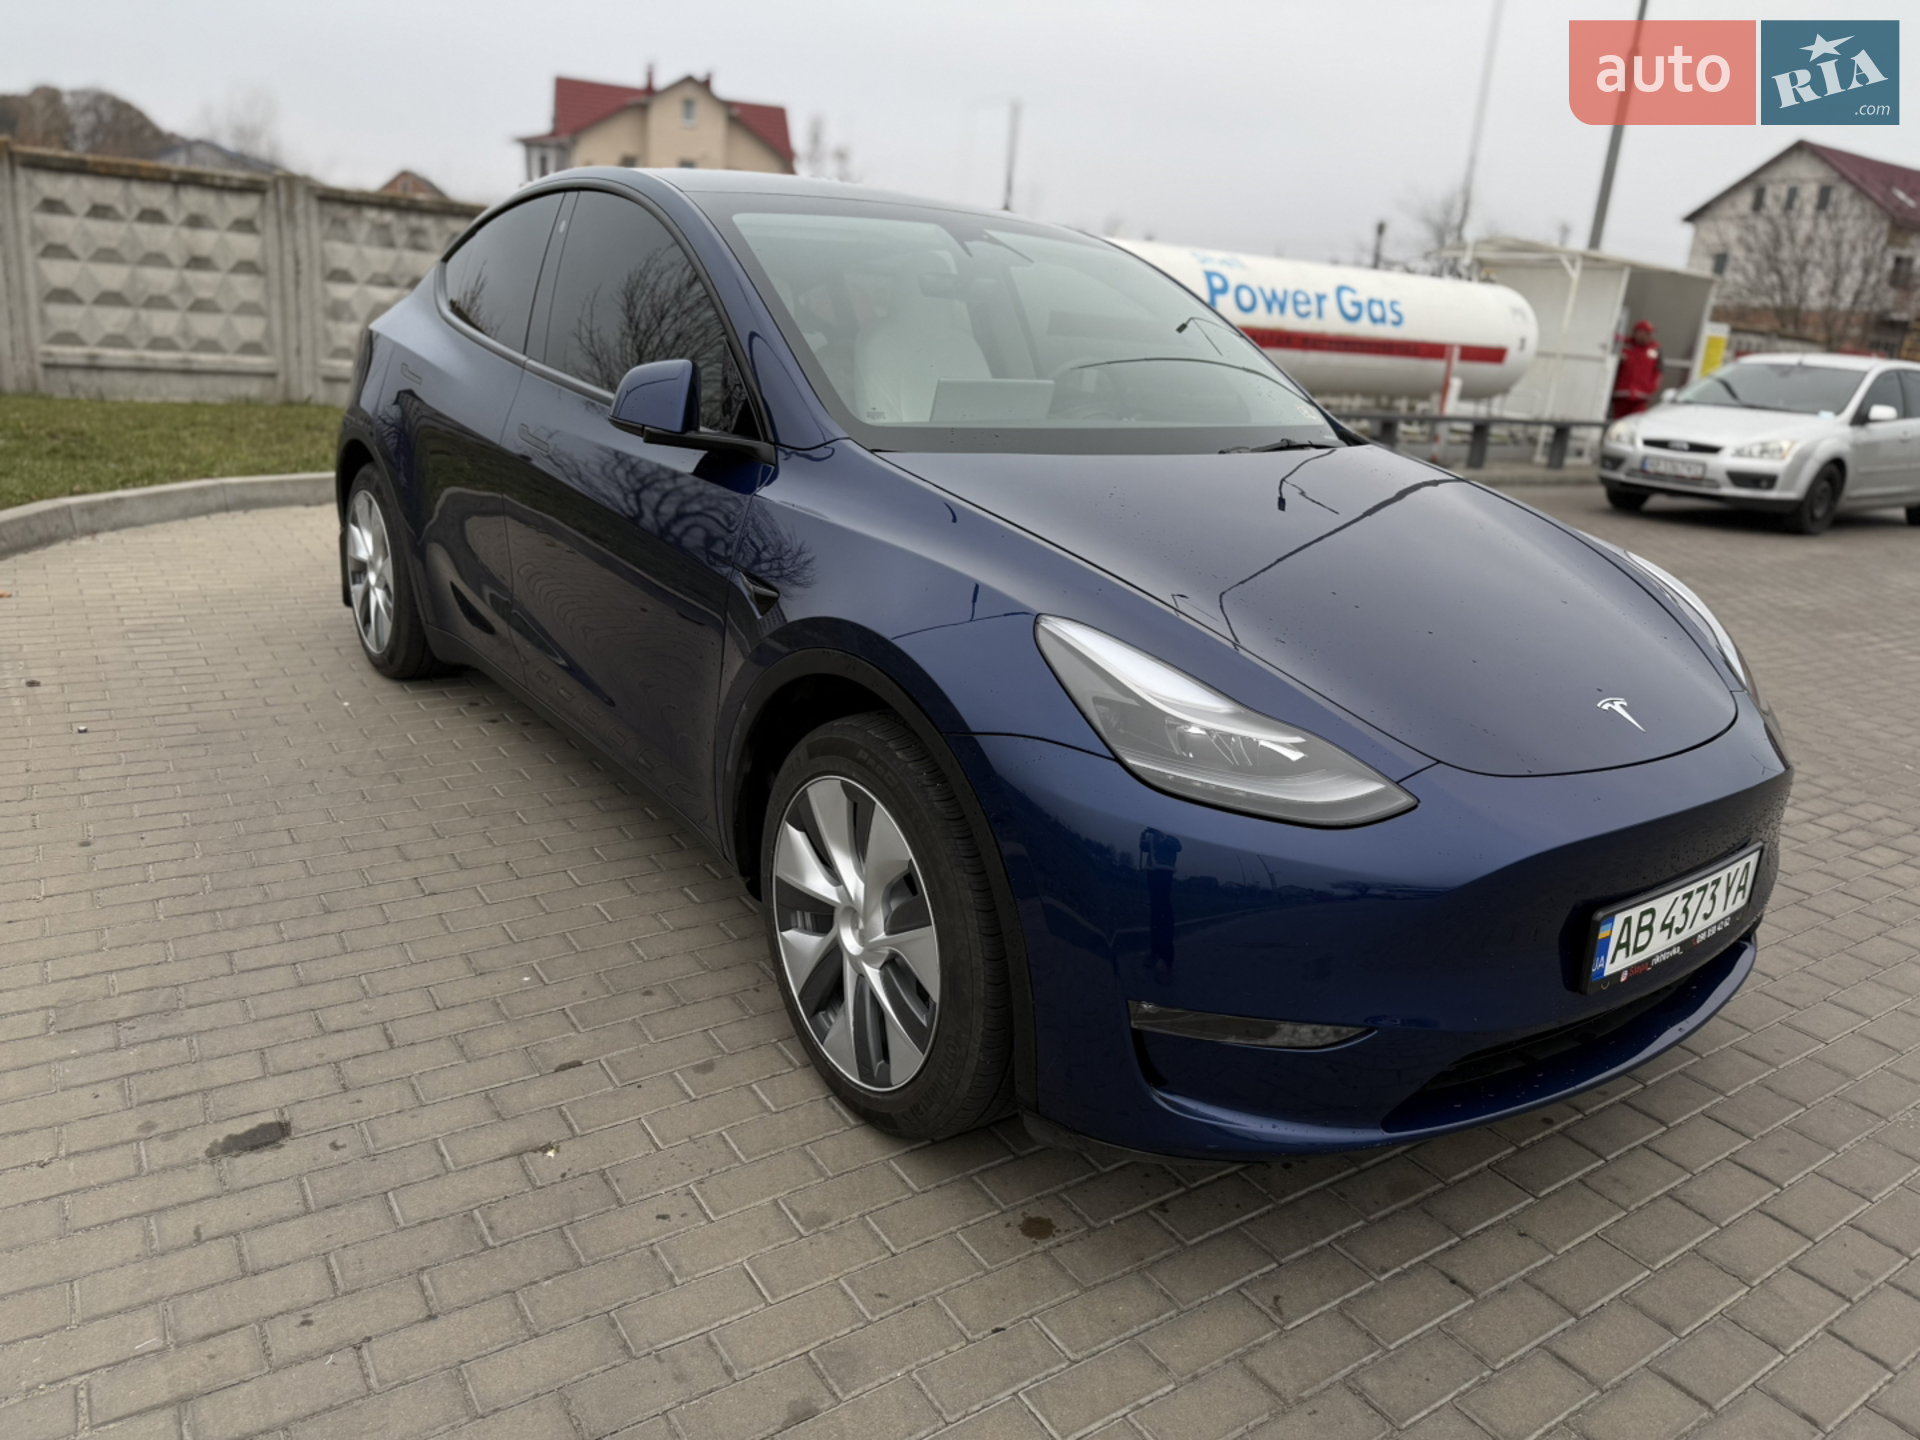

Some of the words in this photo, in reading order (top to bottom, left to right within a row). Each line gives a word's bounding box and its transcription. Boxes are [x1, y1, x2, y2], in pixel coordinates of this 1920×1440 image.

[1204, 270, 1328, 320] Power
[1336, 285, 1404, 327] Gas
[1610, 907, 1657, 965] AB
[1659, 876, 1722, 941] 4373
[1723, 861, 1751, 912] YA
[1592, 956, 1605, 972] UA
